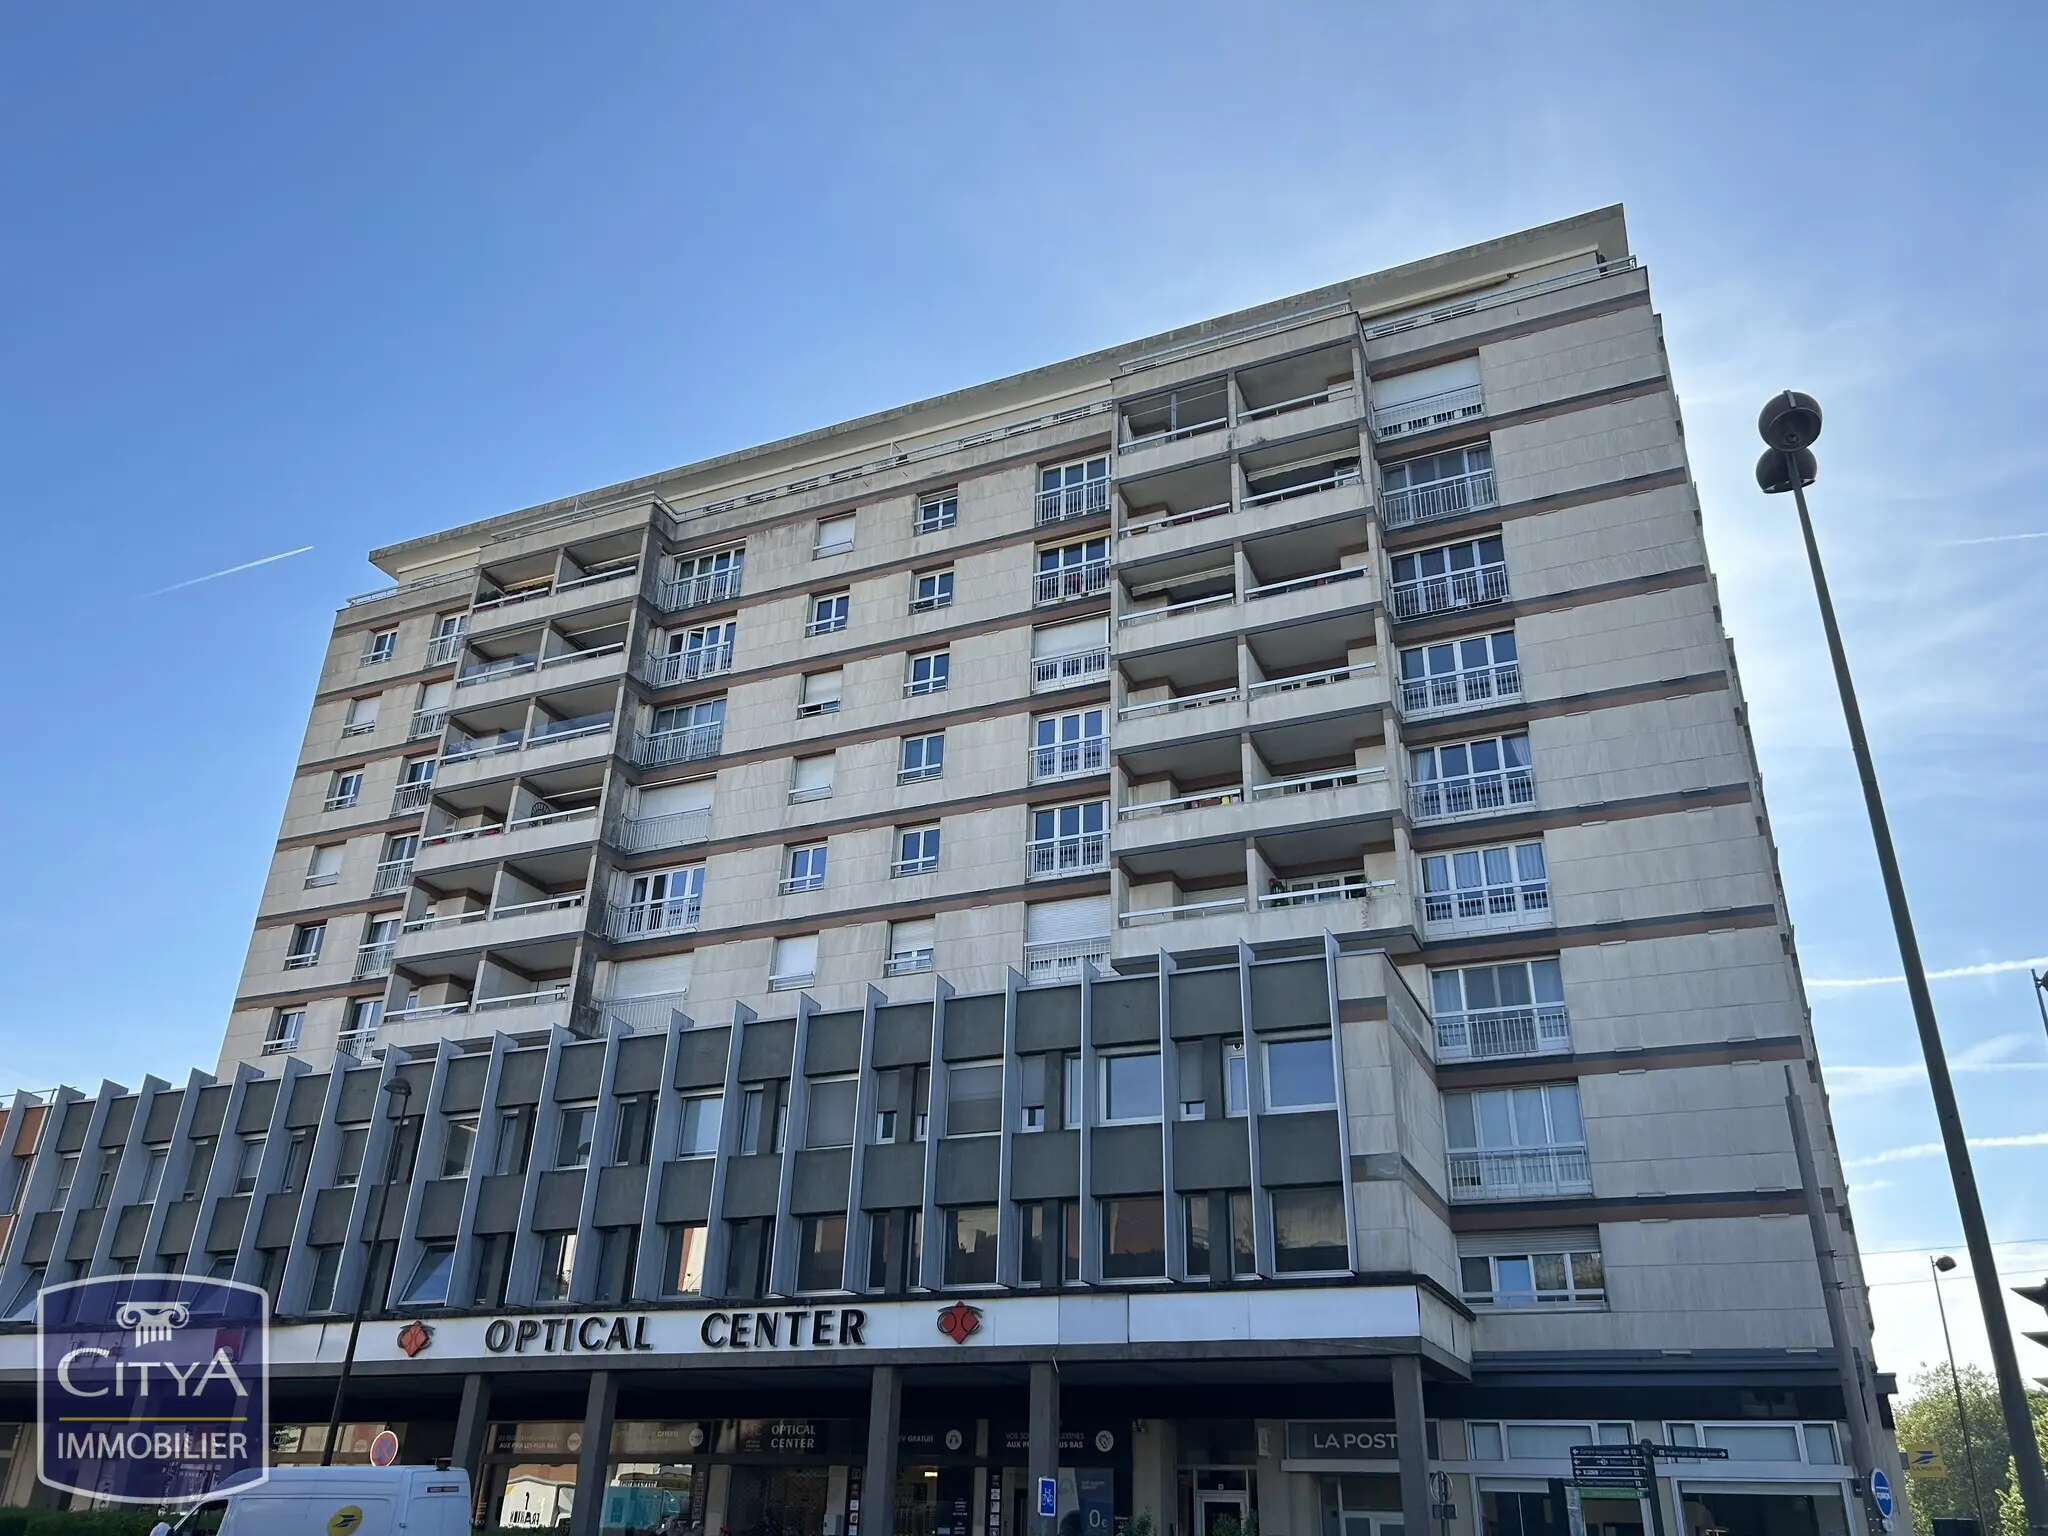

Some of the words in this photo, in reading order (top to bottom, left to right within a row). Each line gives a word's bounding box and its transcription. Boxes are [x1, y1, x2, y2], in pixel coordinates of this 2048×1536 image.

[485, 1316, 653, 1352] OPTICAL
[700, 1309, 868, 1348] CENTER
[771, 1424, 816, 1436] OPTICAL
[770, 1438, 815, 1449] CENTER
[1313, 1433, 1340, 1449] LA
[1343, 1433, 1398, 1449] POST
